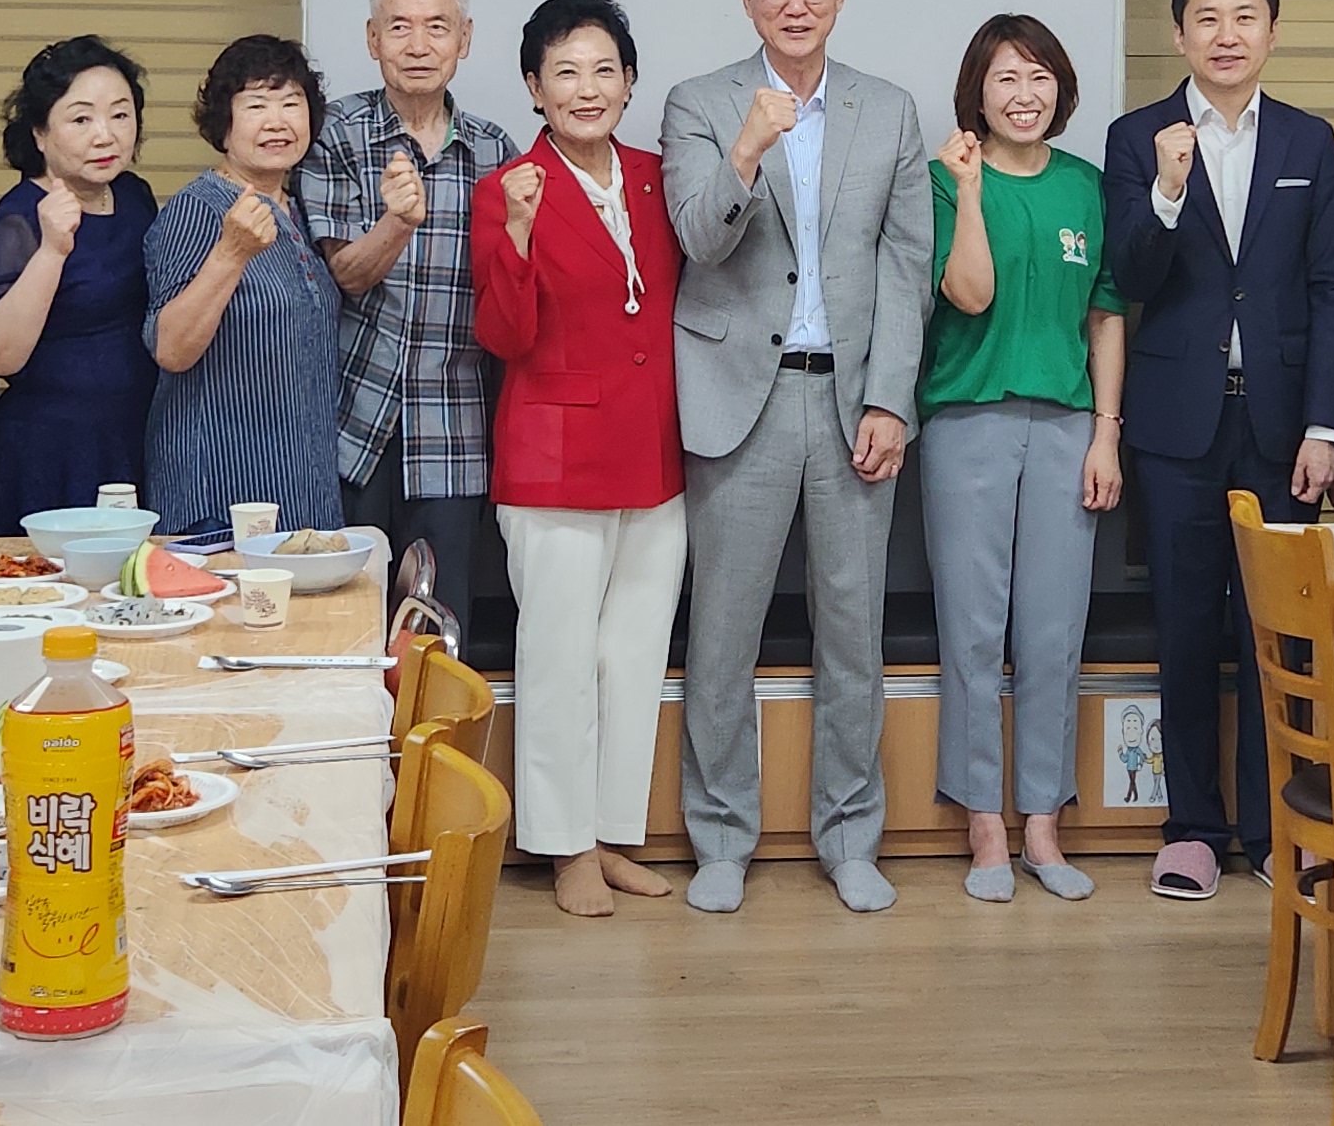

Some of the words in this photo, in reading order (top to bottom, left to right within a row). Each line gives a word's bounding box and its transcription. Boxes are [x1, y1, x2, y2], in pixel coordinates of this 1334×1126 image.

[42, 735, 81, 752] paldo
[27, 792, 97, 833] 비락
[27, 830, 92, 873] 식혜
